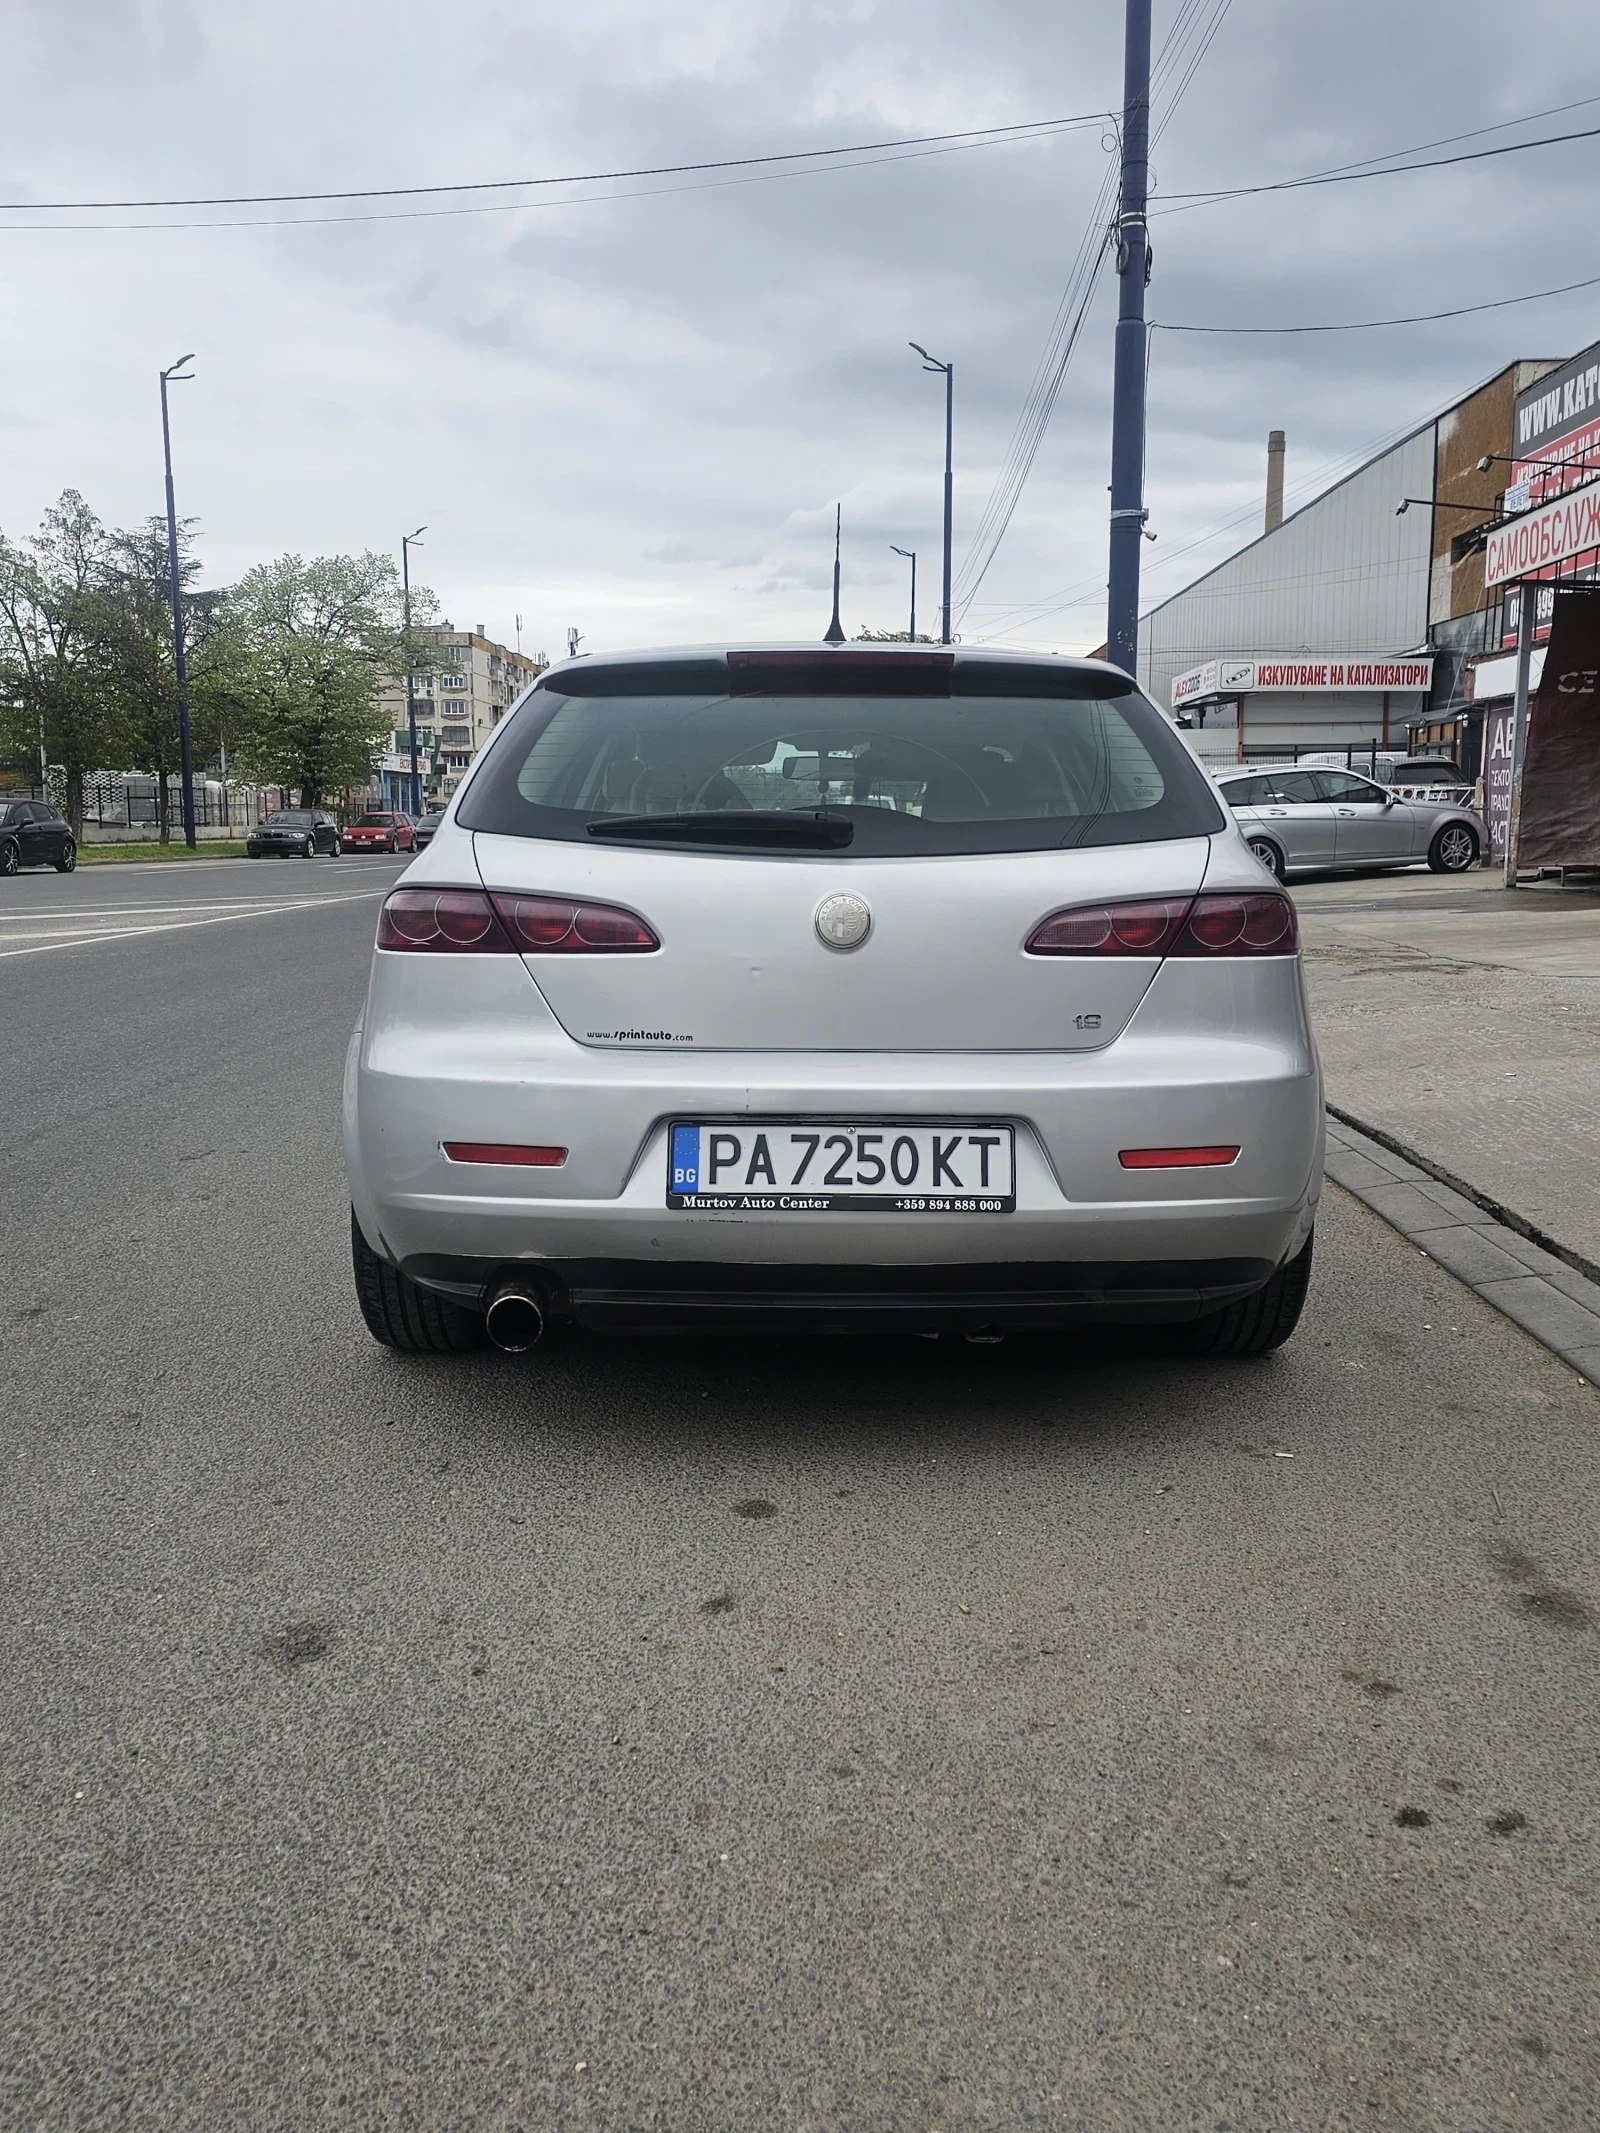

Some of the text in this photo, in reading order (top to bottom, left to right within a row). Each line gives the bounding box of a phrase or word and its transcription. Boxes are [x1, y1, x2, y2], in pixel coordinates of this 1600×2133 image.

[1520, 364, 1600, 444] WWW.KAT
[1258, 664, 1429, 686] ИЗКУПУВАНЕ НА КАТАЛИЗАТОРИ
[586, 1029, 693, 1042] www.sprintauto.com
[708, 1133, 1001, 1188] PA 7250 KT
[674, 1168, 697, 1184] BG
[682, 1196, 830, 1209] Murtov Auto Center
[895, 1199, 1002, 1211] +359 894 888 000
